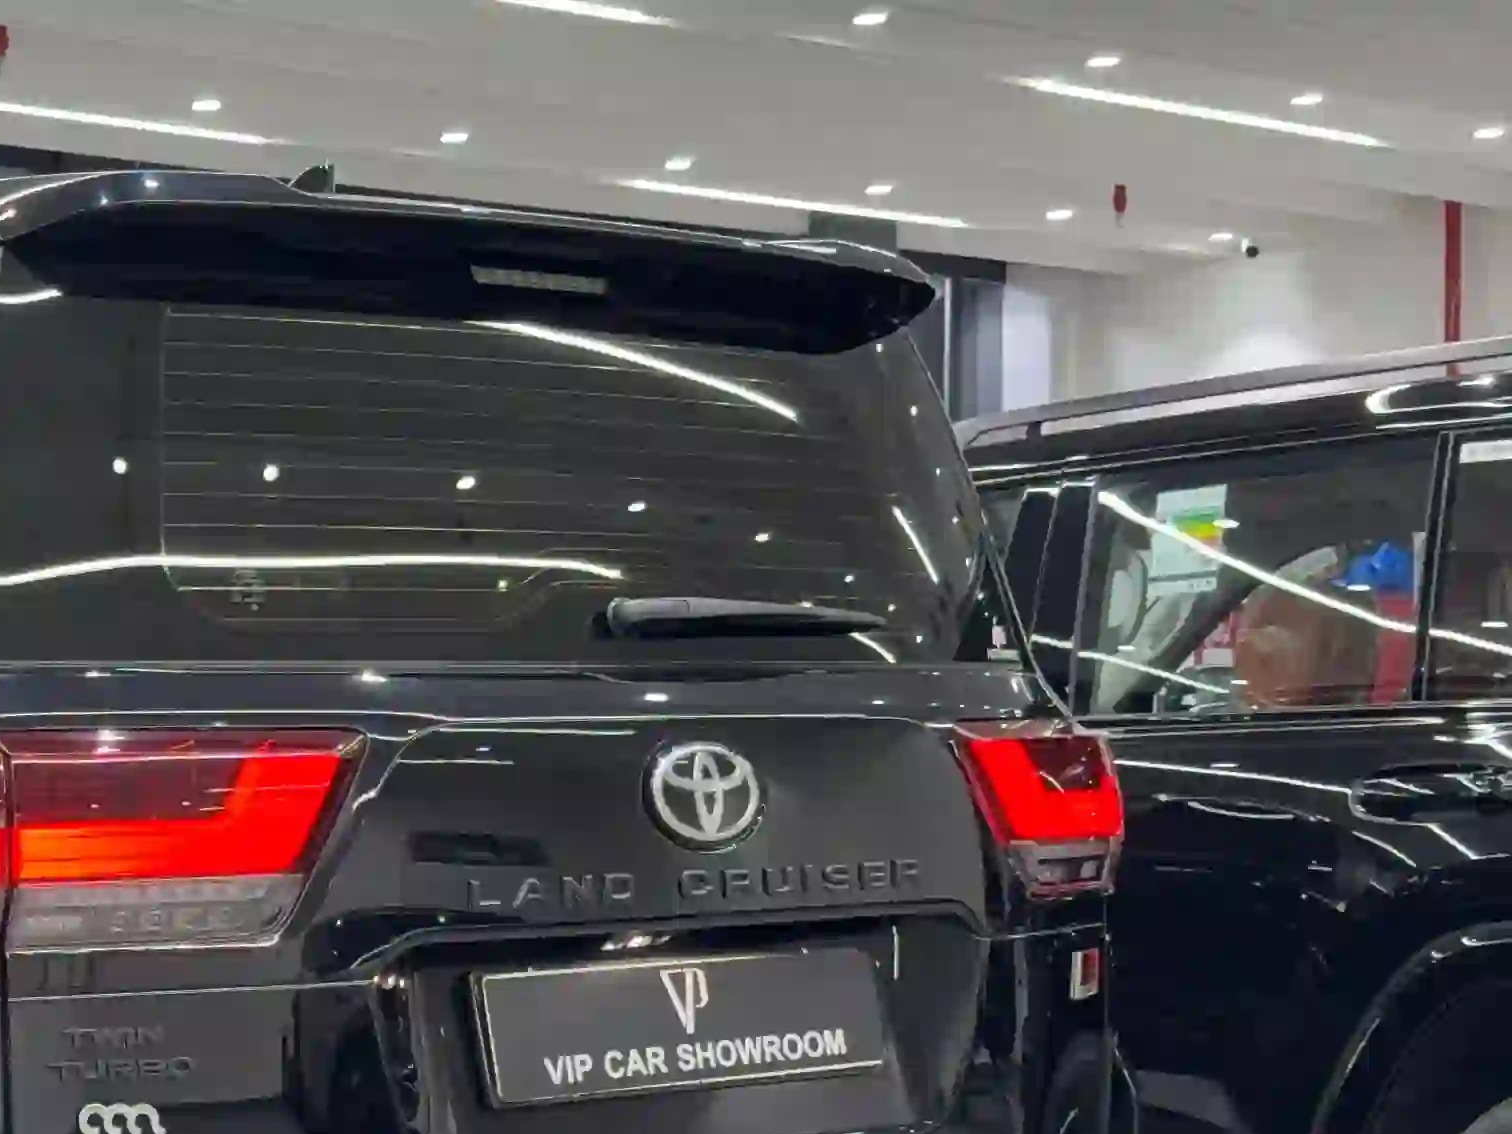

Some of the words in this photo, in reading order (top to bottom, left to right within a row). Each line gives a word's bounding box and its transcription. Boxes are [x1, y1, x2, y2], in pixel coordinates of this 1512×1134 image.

[467, 873, 634, 908] LAND
[678, 858, 920, 899] CRUISER
[62, 1027, 165, 1049] TWIN
[544, 1054, 592, 1085] VIP
[604, 1046, 668, 1079] CAR
[678, 1029, 848, 1072] SHOWROOM
[46, 1055, 196, 1082] TURBO
